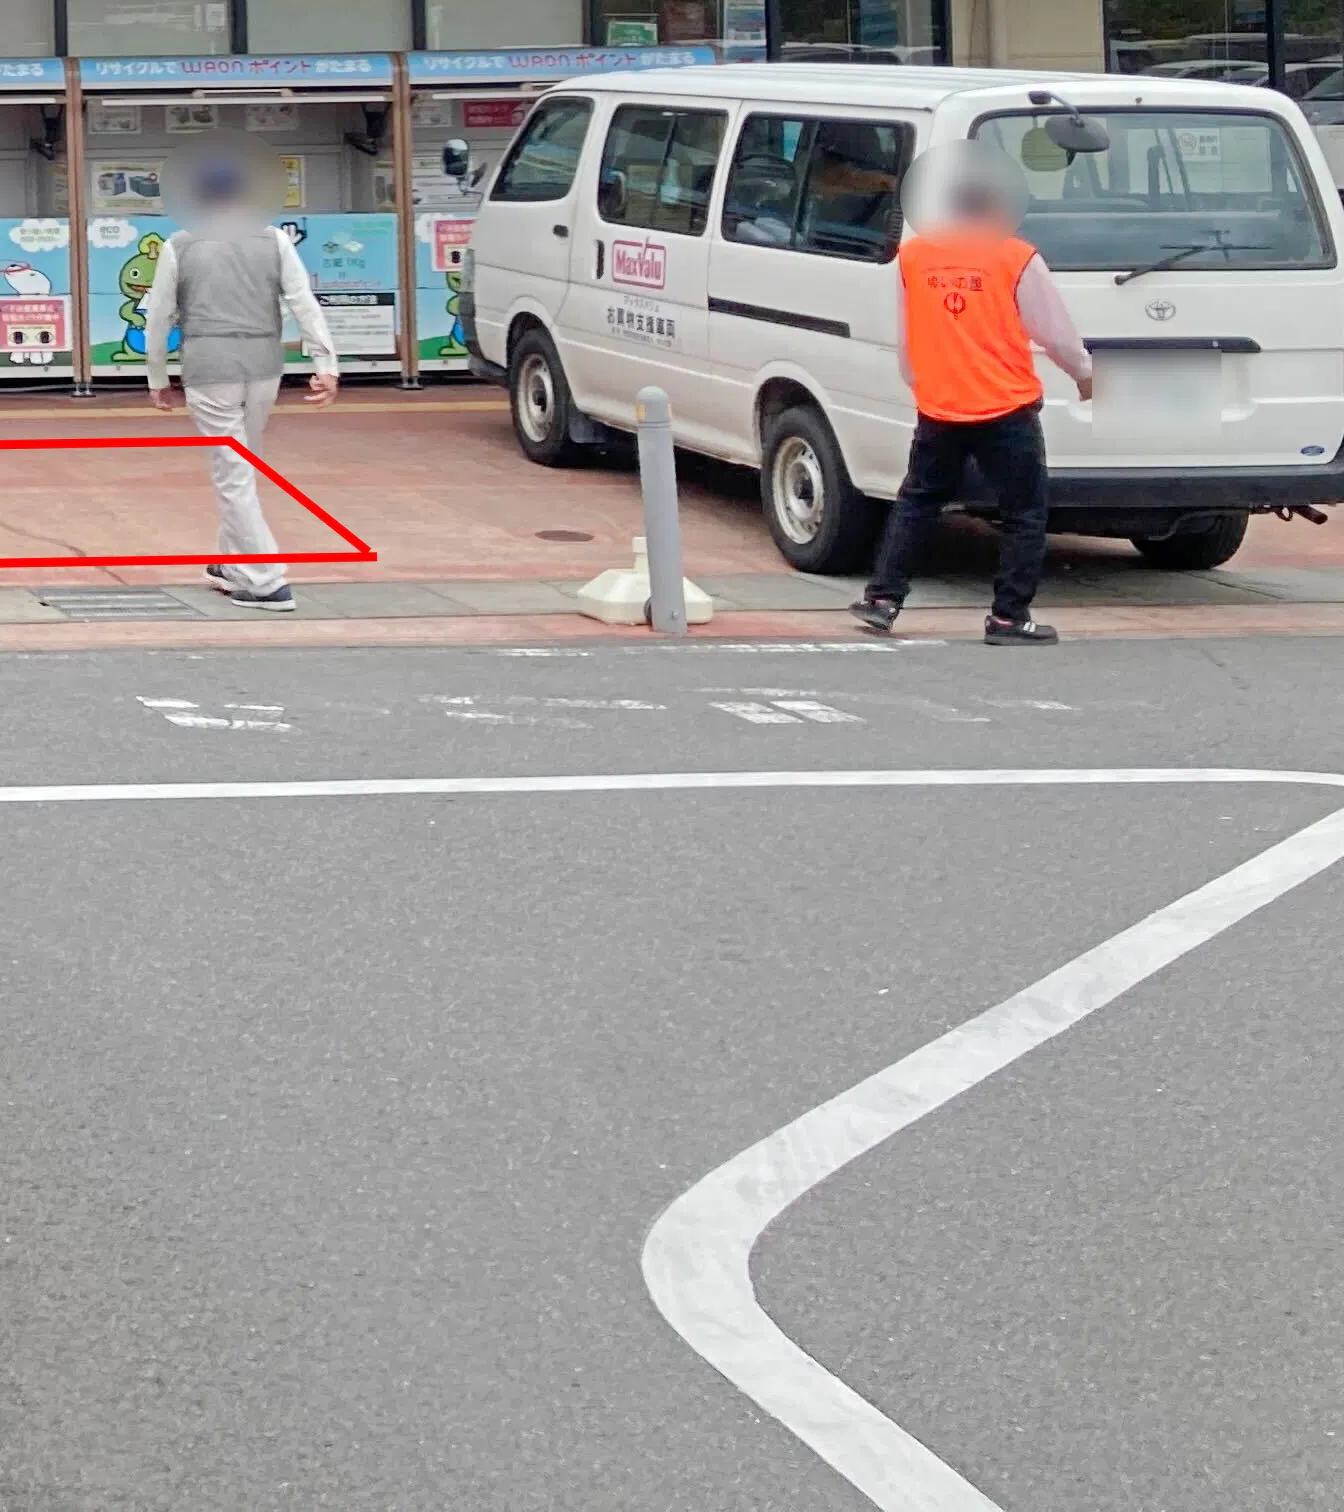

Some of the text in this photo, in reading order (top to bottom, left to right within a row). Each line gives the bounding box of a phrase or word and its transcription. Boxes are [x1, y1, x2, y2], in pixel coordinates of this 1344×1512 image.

[95, 61, 177, 75] リサイクルで
[180, 61, 244, 74] WAON
[249, 60, 311, 74] ポイント
[422, 55, 506, 70] リサイクルで
[508, 55, 571, 69] WAON
[575, 53, 637, 68] ポイント
[615, 241, 662, 281] MaxValu
